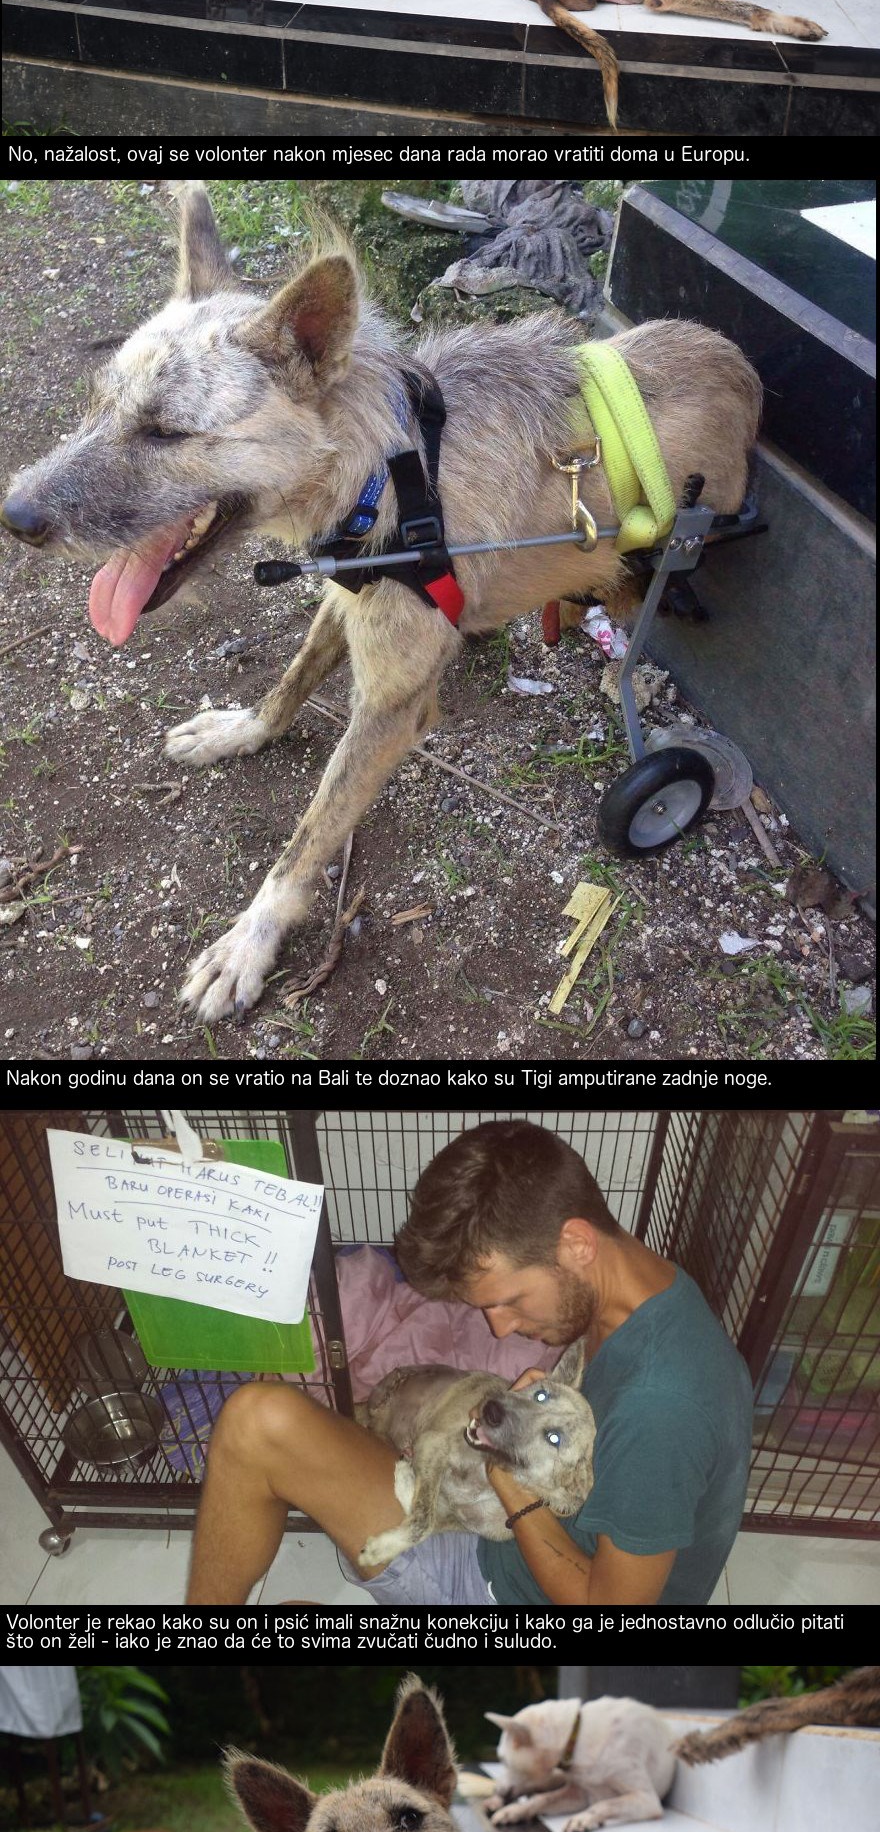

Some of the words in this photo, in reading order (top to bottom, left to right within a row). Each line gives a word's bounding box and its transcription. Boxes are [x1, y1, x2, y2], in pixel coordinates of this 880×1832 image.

[105, 1176, 148, 1192] BARU
[228, 1199, 271, 1222] KAKI
[68, 1201, 124, 1223] Must
[136, 1216, 168, 1230] put
[188, 1220, 260, 1248] THICK
[148, 1239, 253, 1264] BLANKET
[262, 1251, 278, 1272] !!
[151, 1263, 186, 1281] LEG
[196, 1272, 269, 1299] SURGERY
